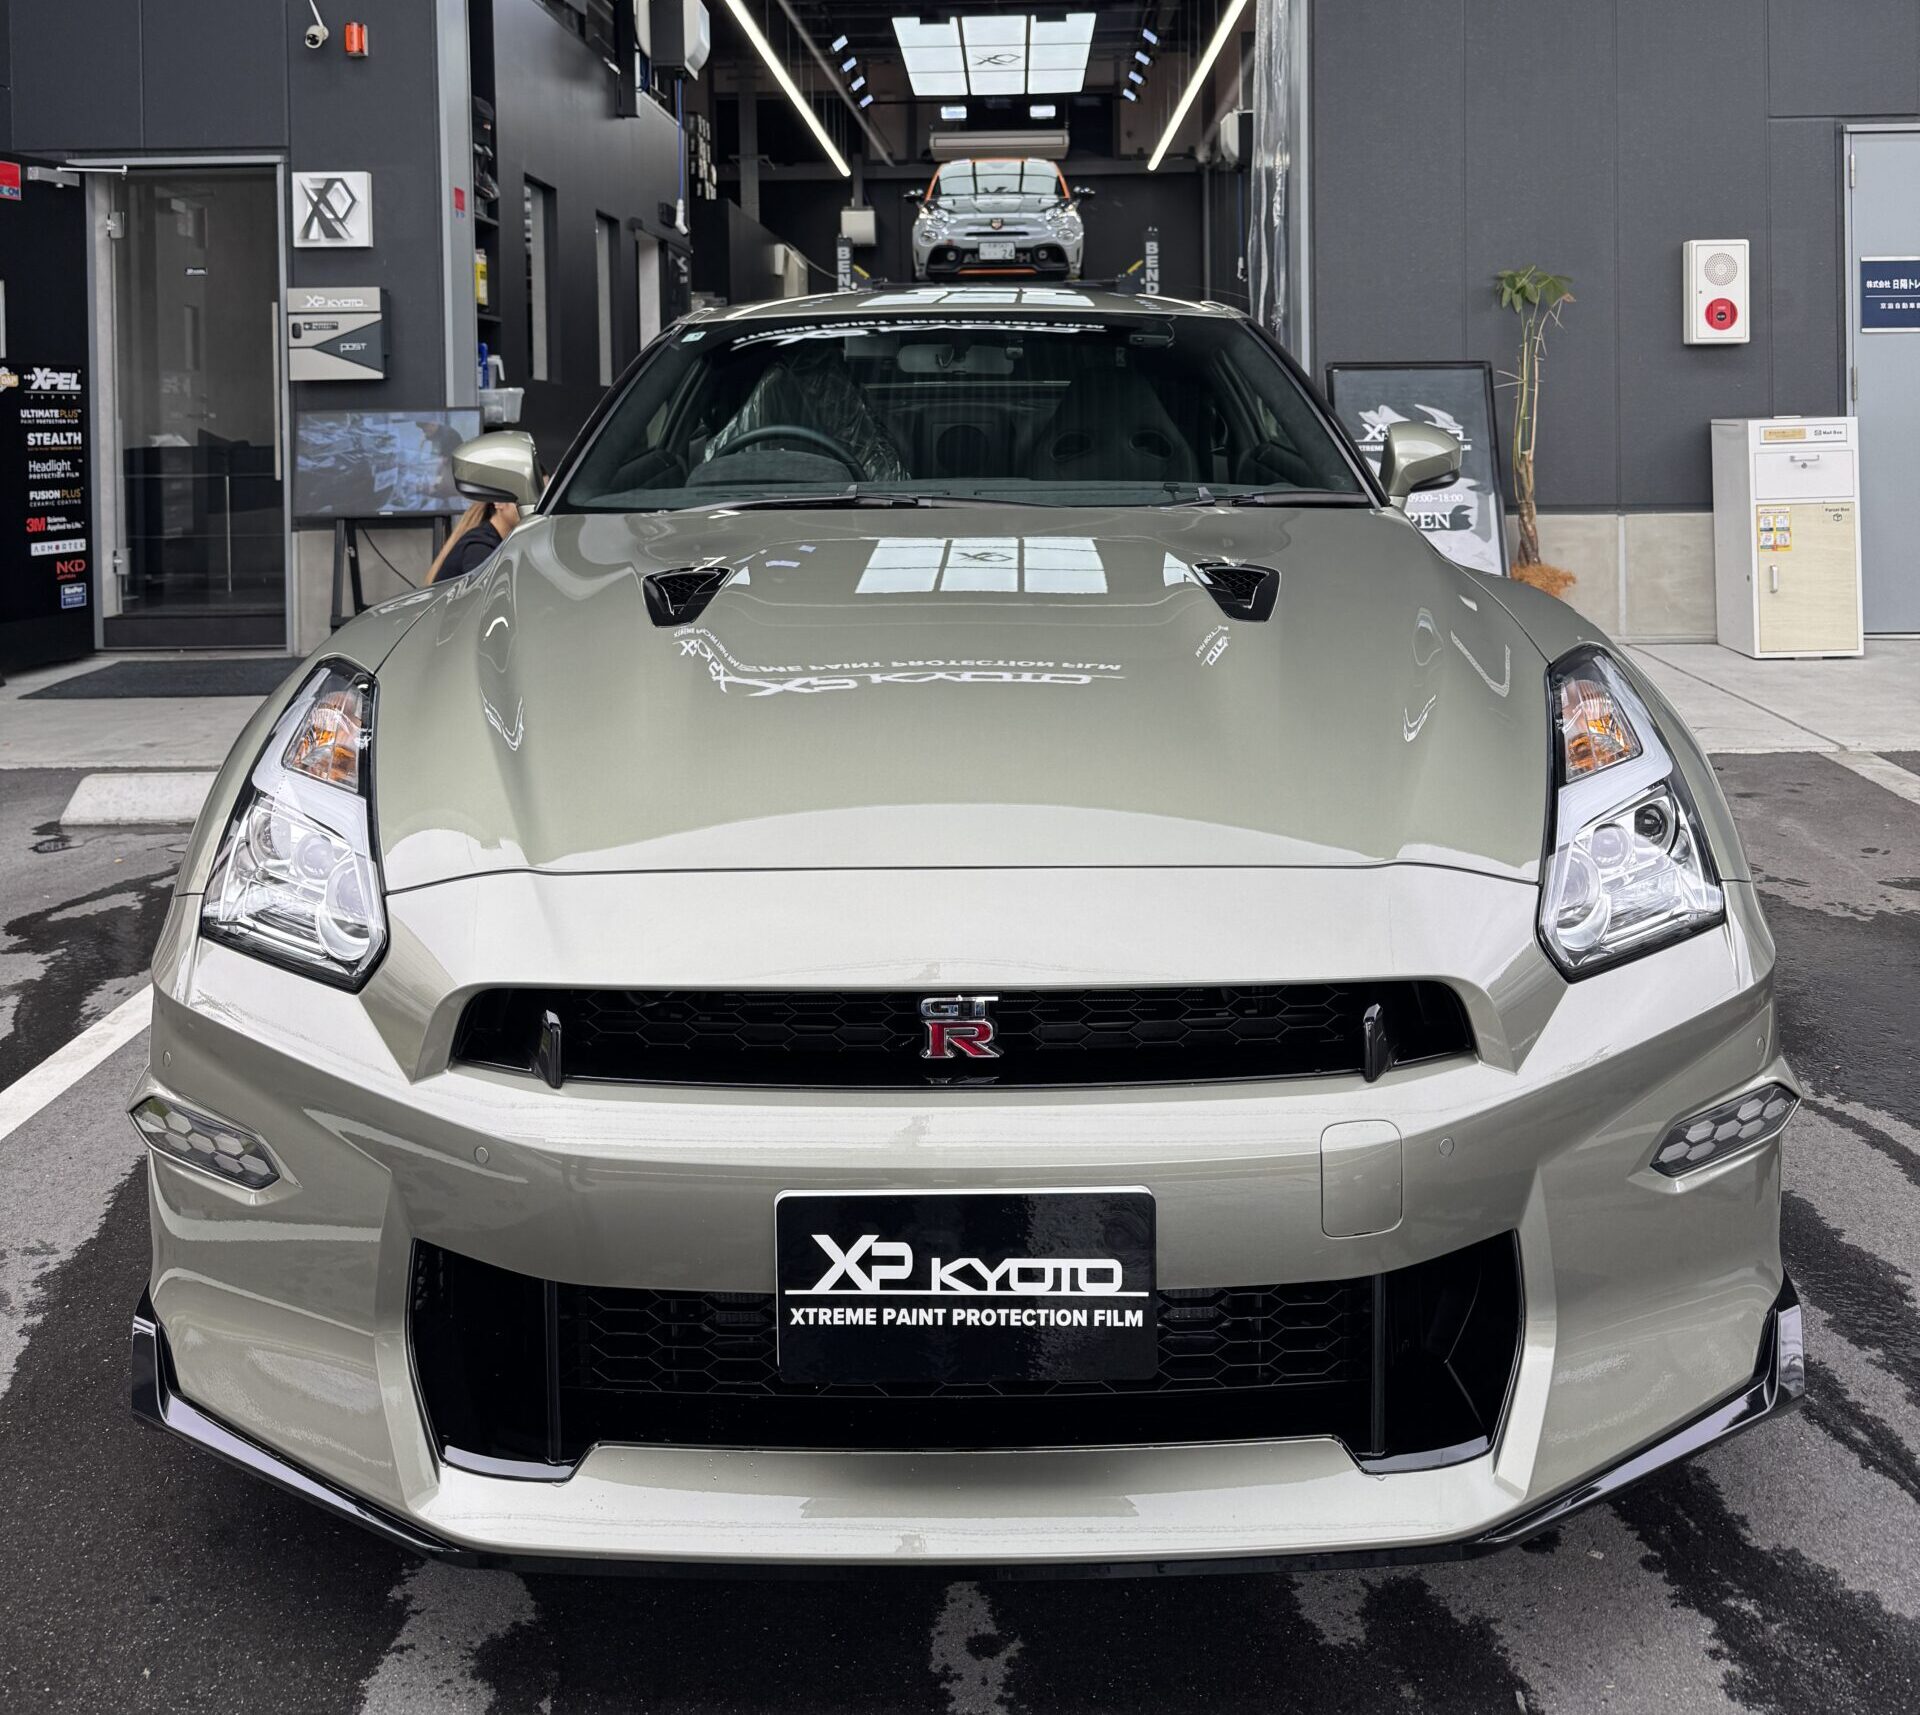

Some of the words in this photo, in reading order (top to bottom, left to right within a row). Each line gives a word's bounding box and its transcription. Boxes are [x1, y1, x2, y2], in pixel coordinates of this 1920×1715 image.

[31, 366, 82, 391] XPEL
[27, 431, 82, 446] STEALTH
[28, 459, 71, 475] Headlight
[26, 517, 47, 533] 3M
[810, 1234, 914, 1293] XP
[931, 1257, 1123, 1294] KYOTO
[789, 1307, 876, 1326] XTREME
[883, 1308, 946, 1327] PAINT
[952, 1308, 1088, 1328] PROTECTION
[1093, 1309, 1144, 1328] FILM
